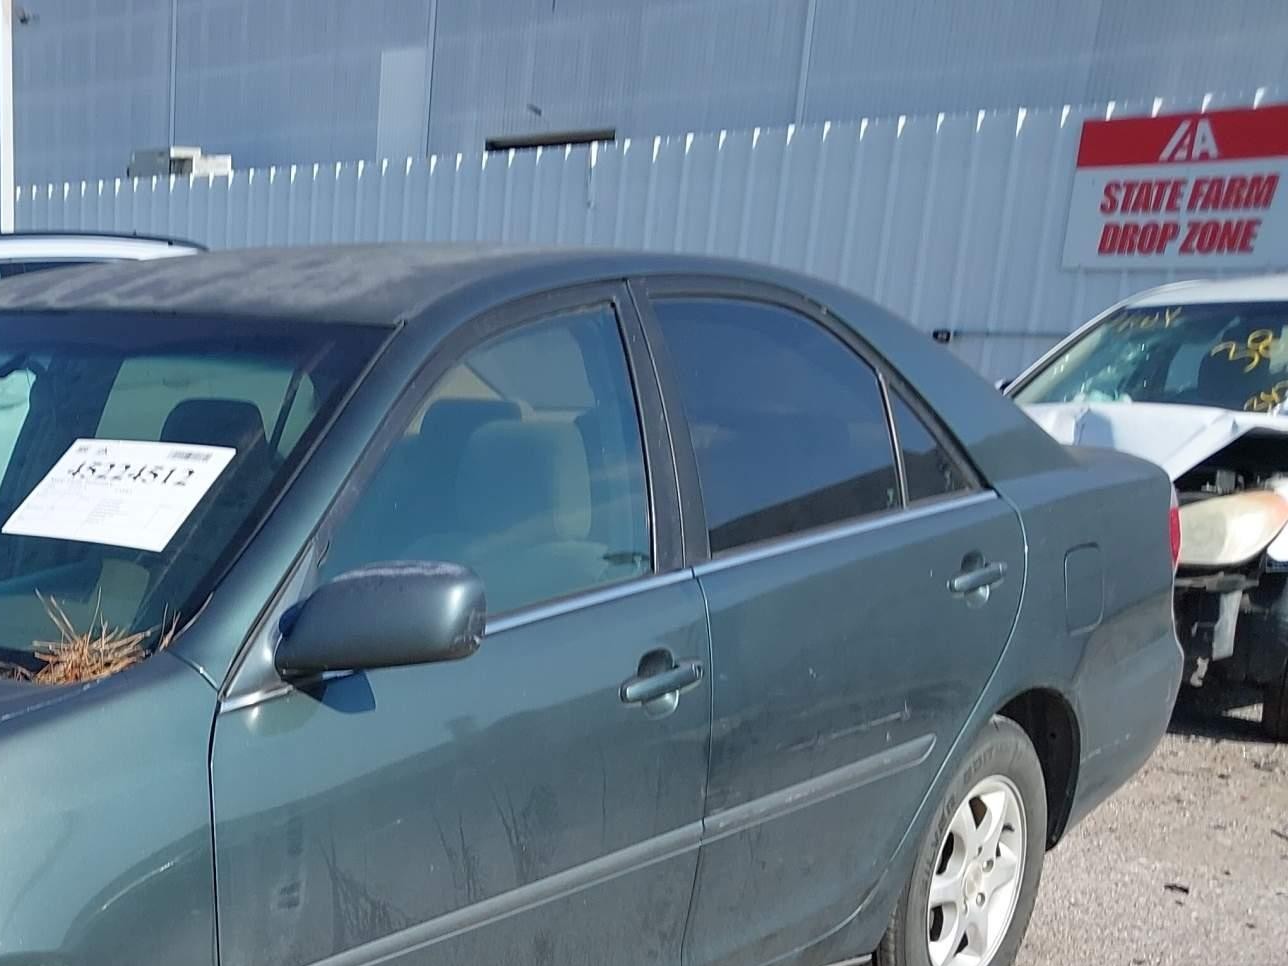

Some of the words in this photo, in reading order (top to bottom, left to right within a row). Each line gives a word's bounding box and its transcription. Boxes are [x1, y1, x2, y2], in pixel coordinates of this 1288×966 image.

[1100, 178, 1188, 216] STATE
[1186, 172, 1280, 213] FARM
[1098, 220, 1181, 256] DROP
[1178, 217, 1262, 255] ZONE
[67, 460, 196, 486] 45224512
